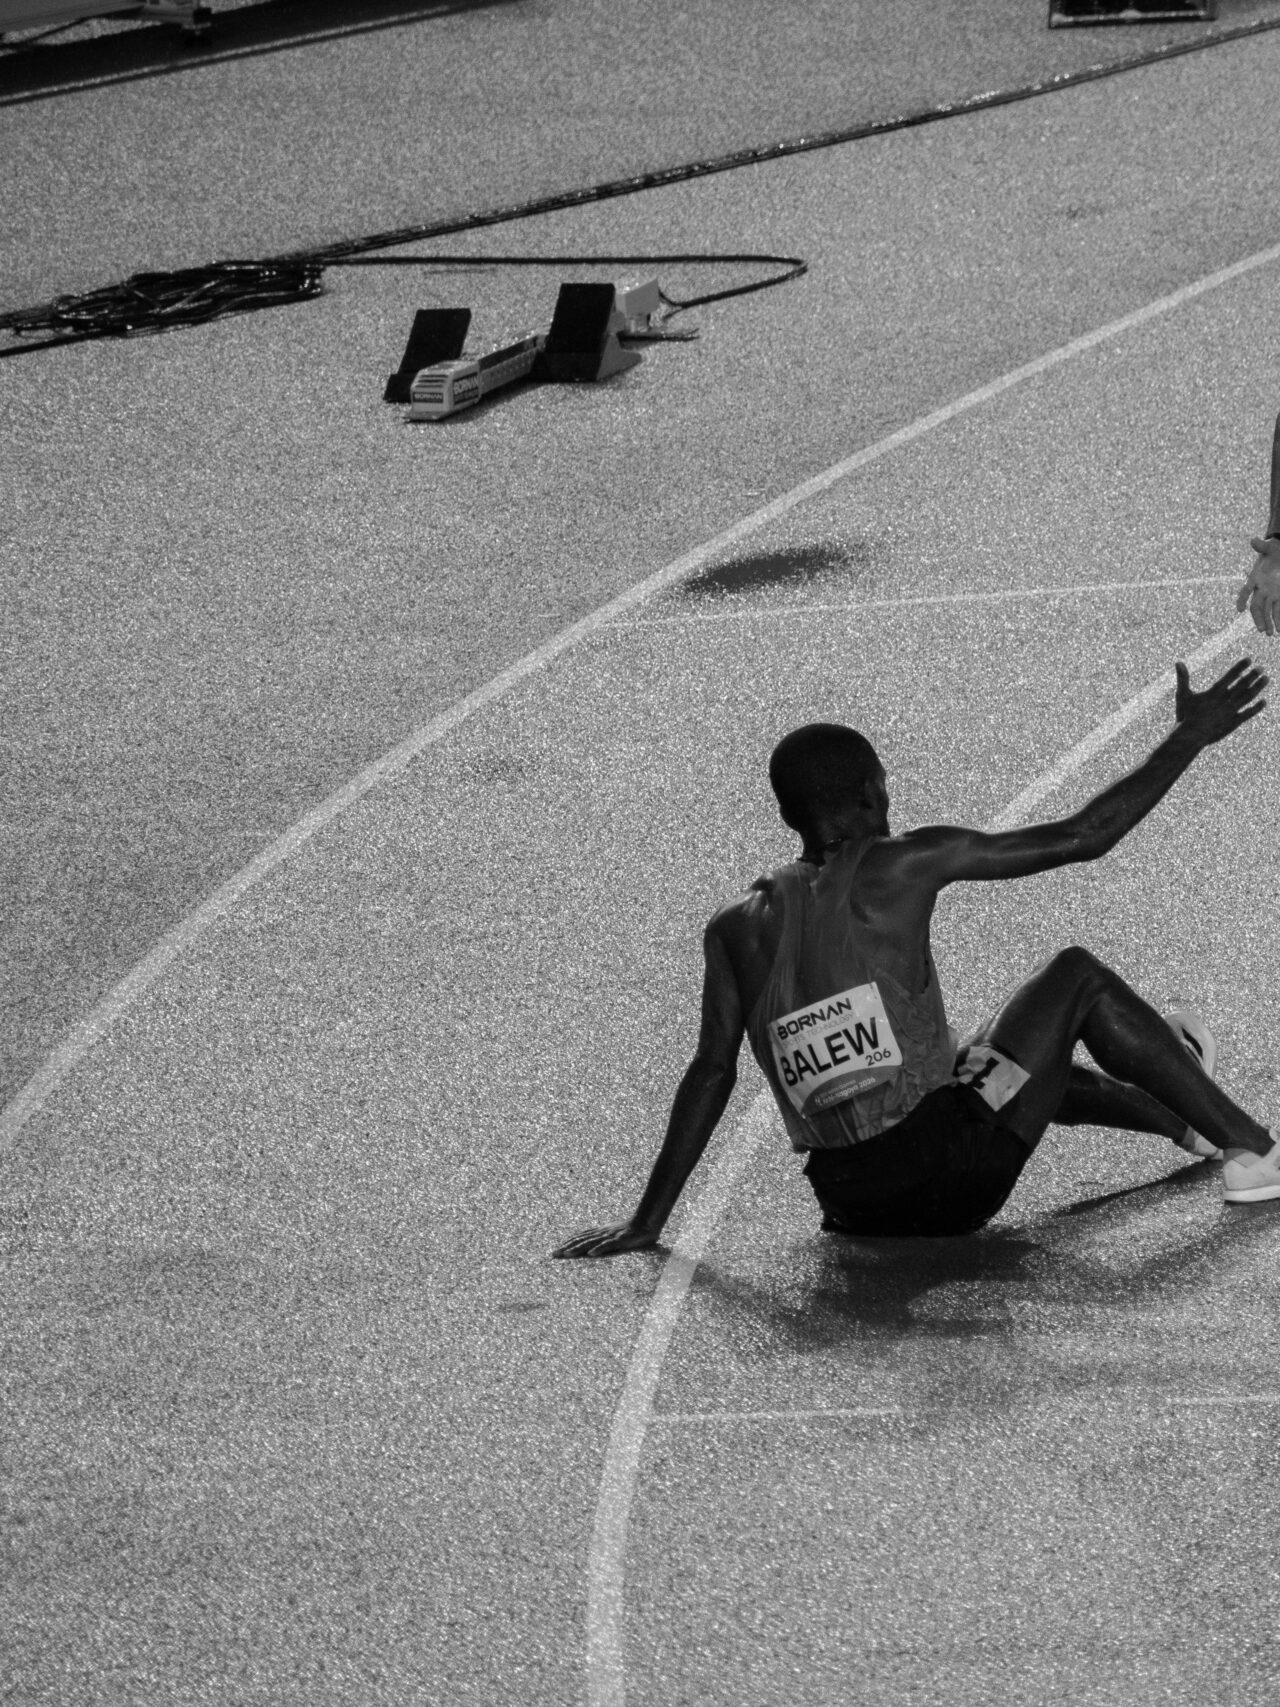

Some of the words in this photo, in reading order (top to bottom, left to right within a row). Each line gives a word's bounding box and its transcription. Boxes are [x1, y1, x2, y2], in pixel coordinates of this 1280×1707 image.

[777, 998, 852, 1041] BORNAN
[780, 1016, 879, 1087] BALEW
[865, 1048, 892, 1066] 206
[859, 1077, 876, 1089] 2026
